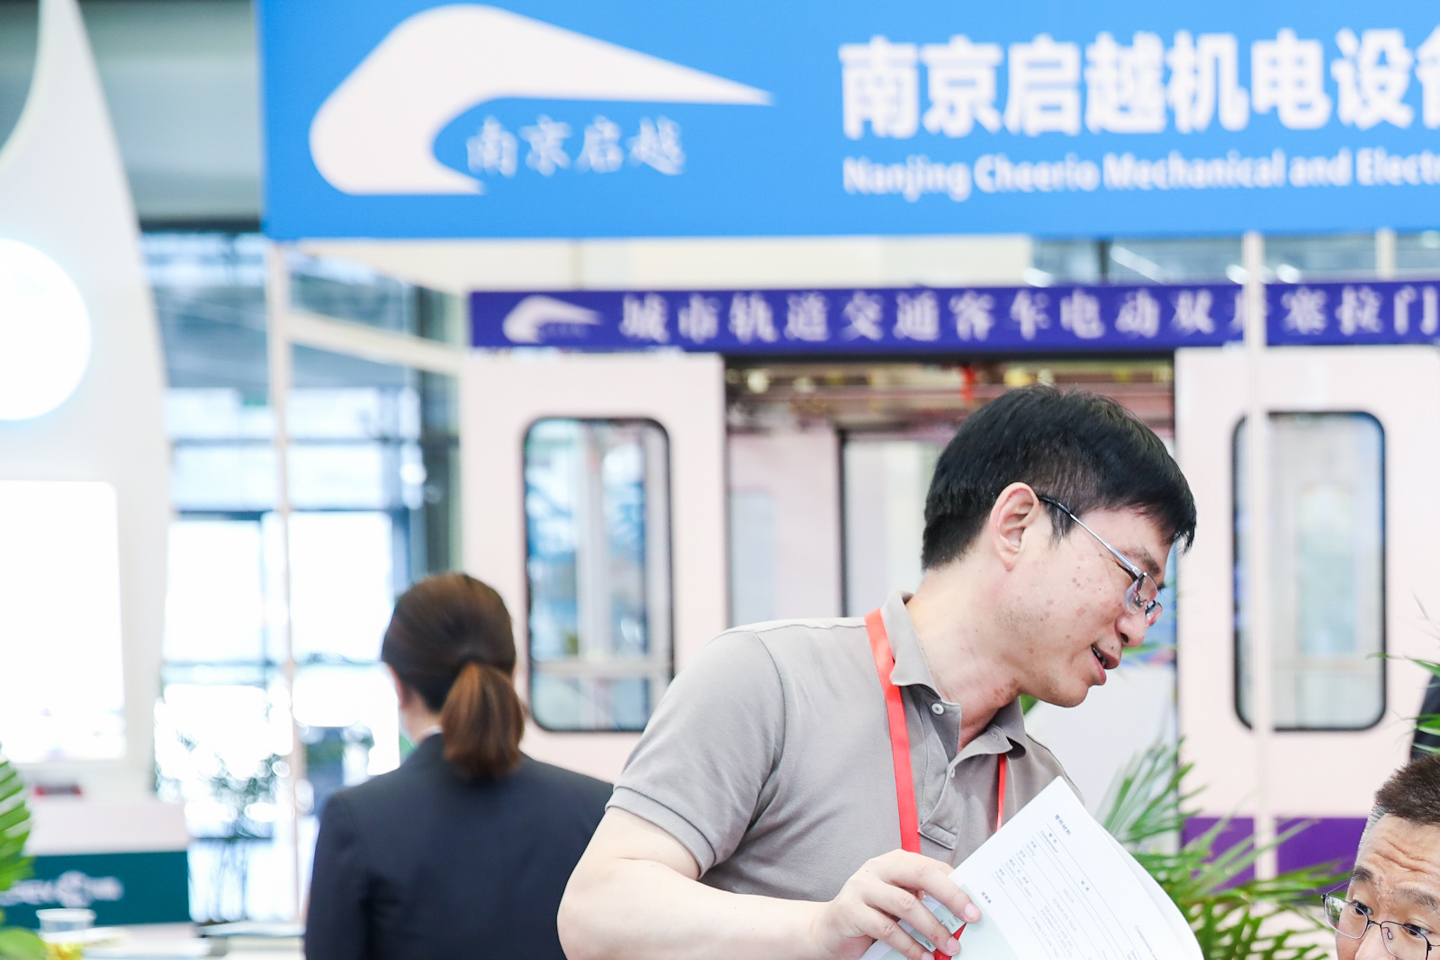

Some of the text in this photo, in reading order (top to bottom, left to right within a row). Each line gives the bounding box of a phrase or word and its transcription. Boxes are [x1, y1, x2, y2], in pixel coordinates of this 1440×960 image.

[466, 115, 687, 177] 南京启越
[842, 155, 972, 202] Nanjing
[973, 152, 1100, 193] Cheerio
[1102, 148, 1285, 191] Mechanical
[1288, 146, 1352, 187] and
